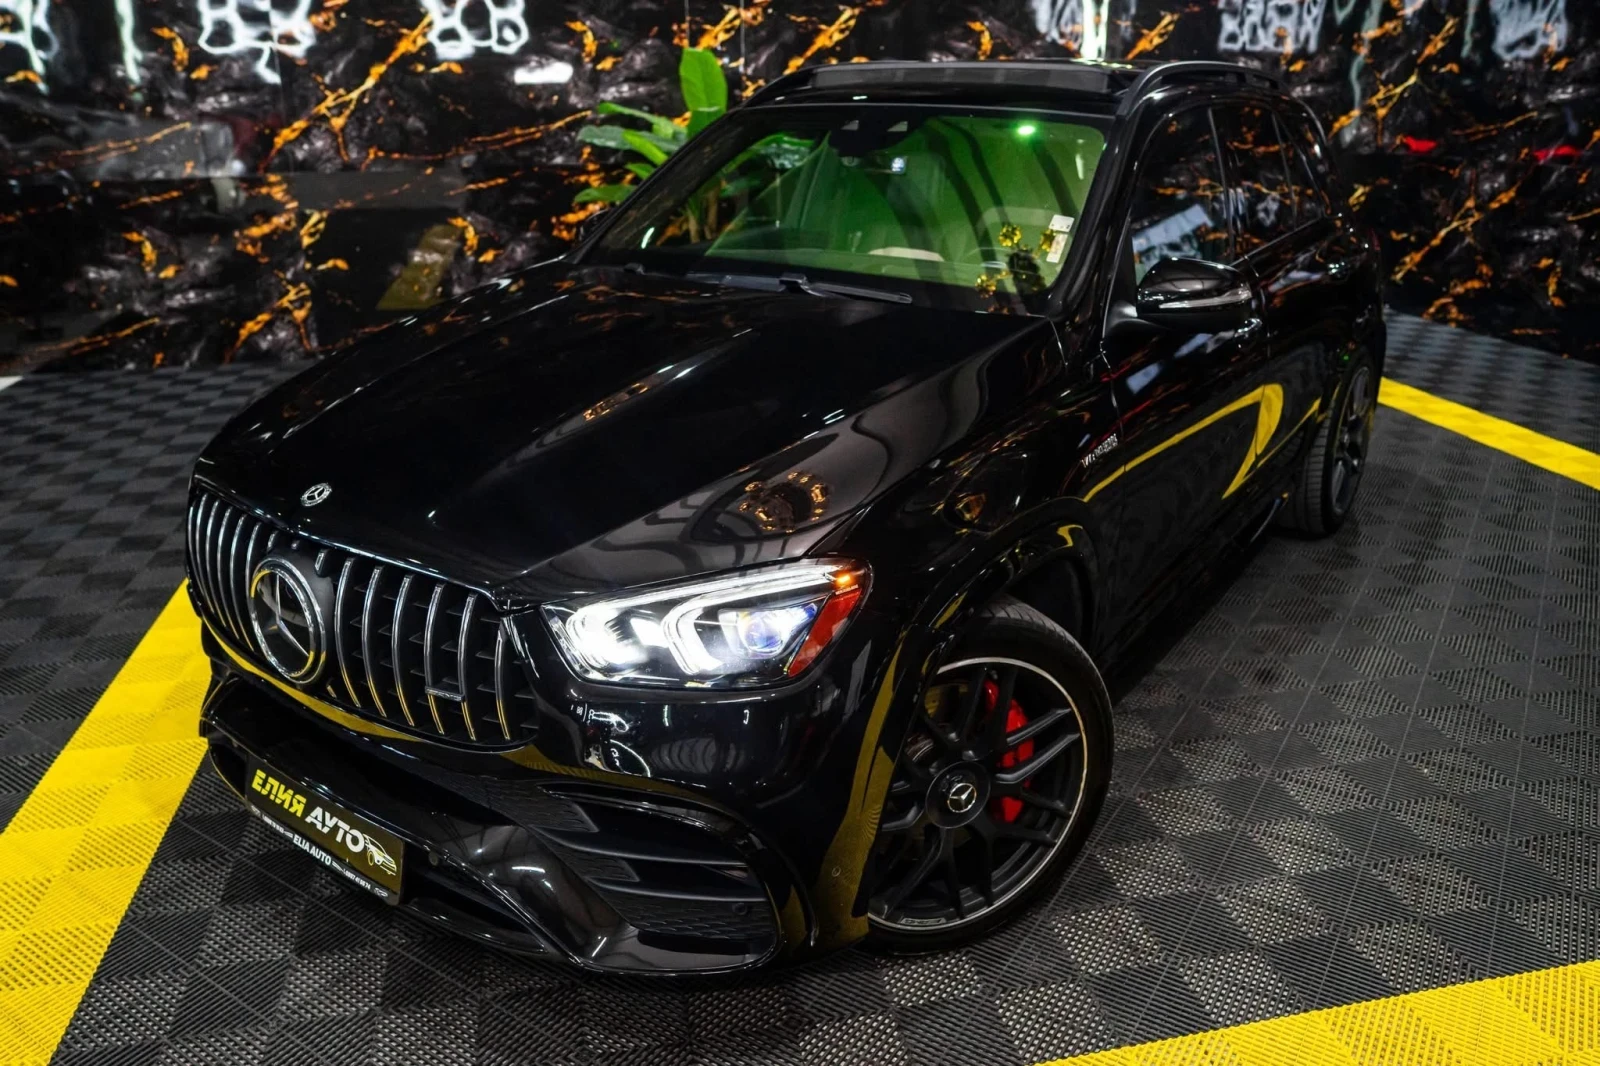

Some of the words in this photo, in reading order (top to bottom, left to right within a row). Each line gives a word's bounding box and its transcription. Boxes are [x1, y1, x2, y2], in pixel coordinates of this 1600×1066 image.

[252, 769, 306, 817] ЕЛИЯ
[305, 807, 365, 853] АУТО
[294, 835, 310, 852] ELIA
[309, 847, 332, 866] AUTO
